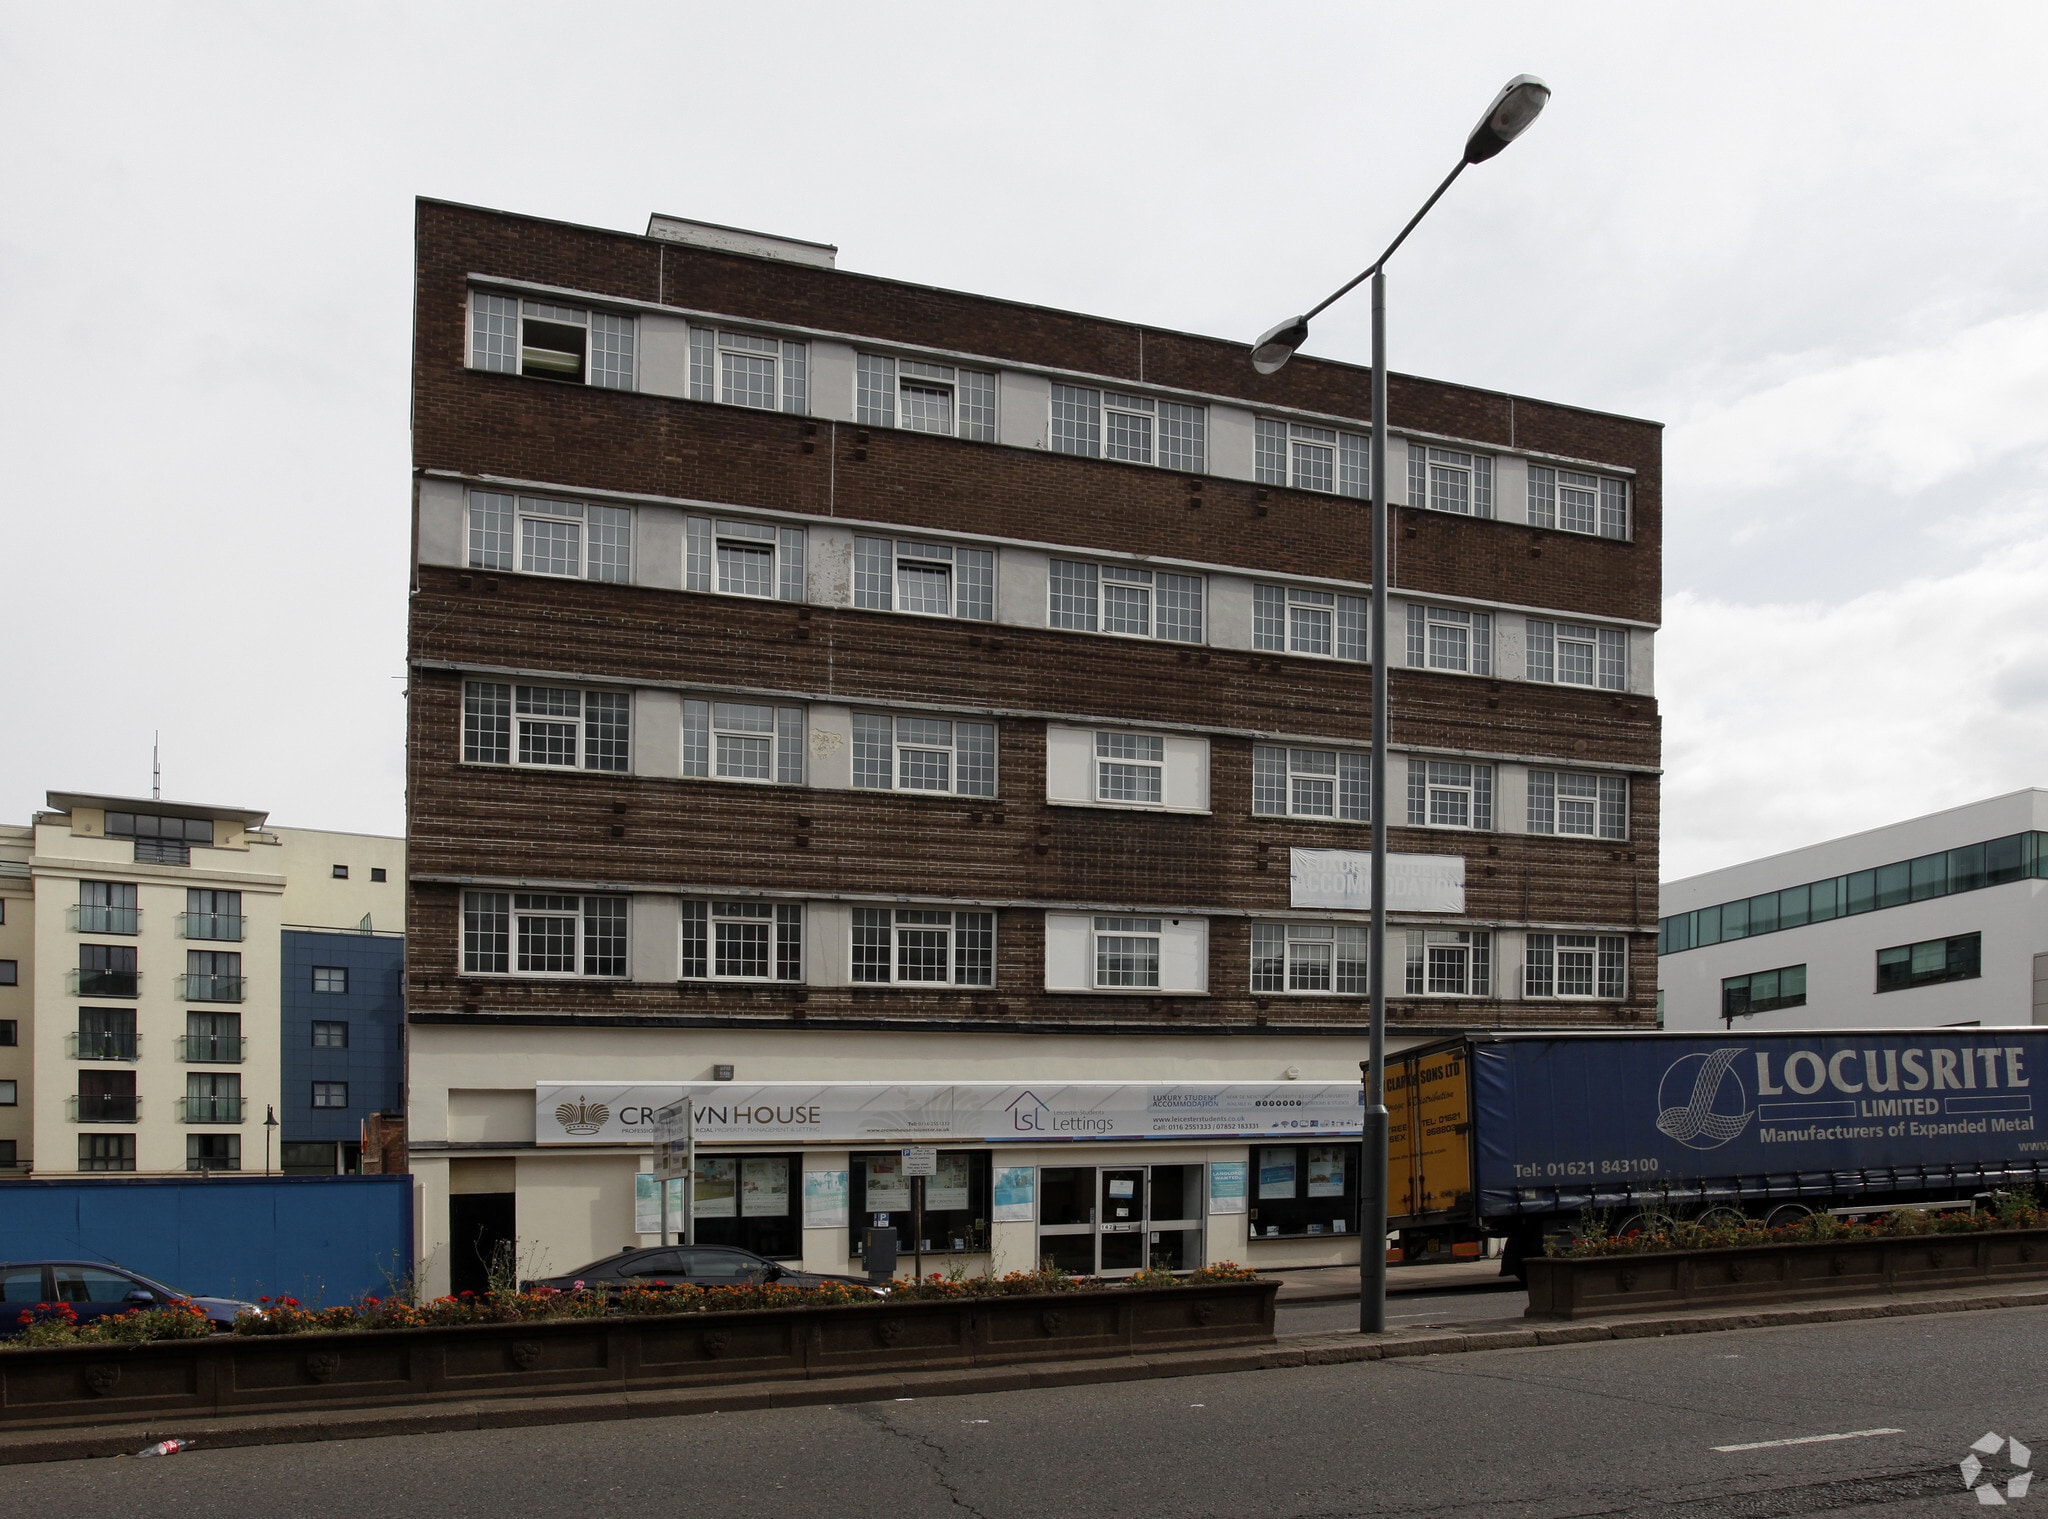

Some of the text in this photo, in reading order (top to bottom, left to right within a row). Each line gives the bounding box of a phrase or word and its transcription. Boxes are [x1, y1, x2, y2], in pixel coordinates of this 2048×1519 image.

[1420, 1066, 1444, 1084] SONS
[1445, 1062, 1460, 1078] LTD
[1755, 1047, 2030, 1096] LOCUSRITE
[733, 1106, 821, 1125] HOUSE
[1861, 1098, 1940, 1118] LIMITED
[1053, 1117, 1114, 1134] Lettings
[1421, 1118, 1436, 1127] TEL:
[1439, 1112, 1461, 1124] 01621
[1760, 1116, 2034, 1143] Manufacturers of Expanded Metal
[1513, 1158, 1659, 1178] Tel: 01621 843100
[880, 1213, 887, 1221] P
